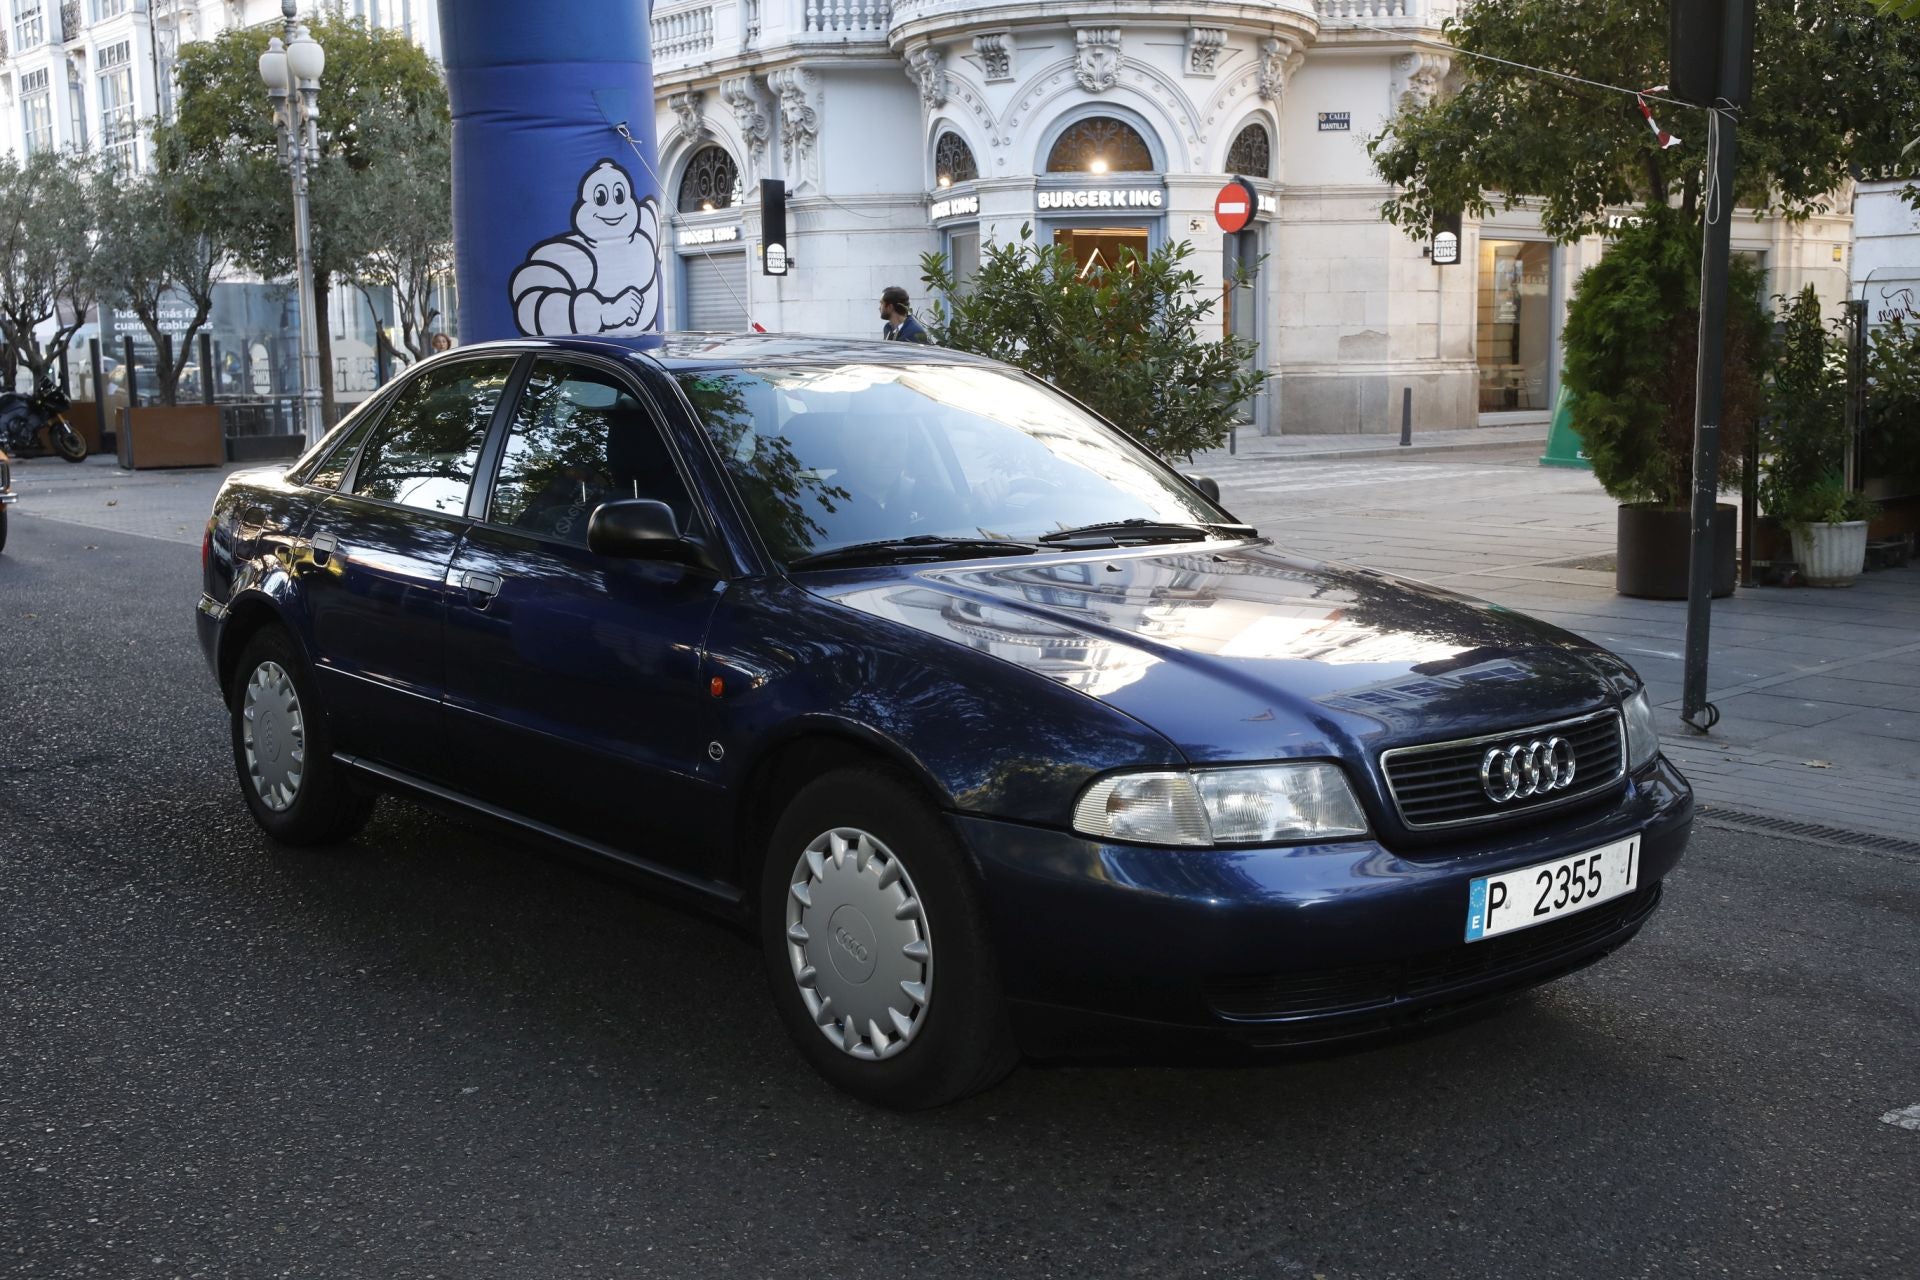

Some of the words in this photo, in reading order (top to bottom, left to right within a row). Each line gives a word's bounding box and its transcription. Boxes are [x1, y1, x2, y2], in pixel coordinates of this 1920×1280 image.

[1329, 112, 1350, 120] CALLE
[1320, 122, 1348, 130] MANTILLA
[1038, 191, 1111, 208] BURGER
[1113, 190, 1161, 207] KING
[680, 229, 713, 245] BURGER
[714, 226, 736, 241] KING
[1434, 247, 1457, 257] KING
[767, 259, 785, 267] KING
[1486, 881, 1507, 929] P
[1533, 854, 1602, 916] 2355
[1472, 915, 1480, 929] E
